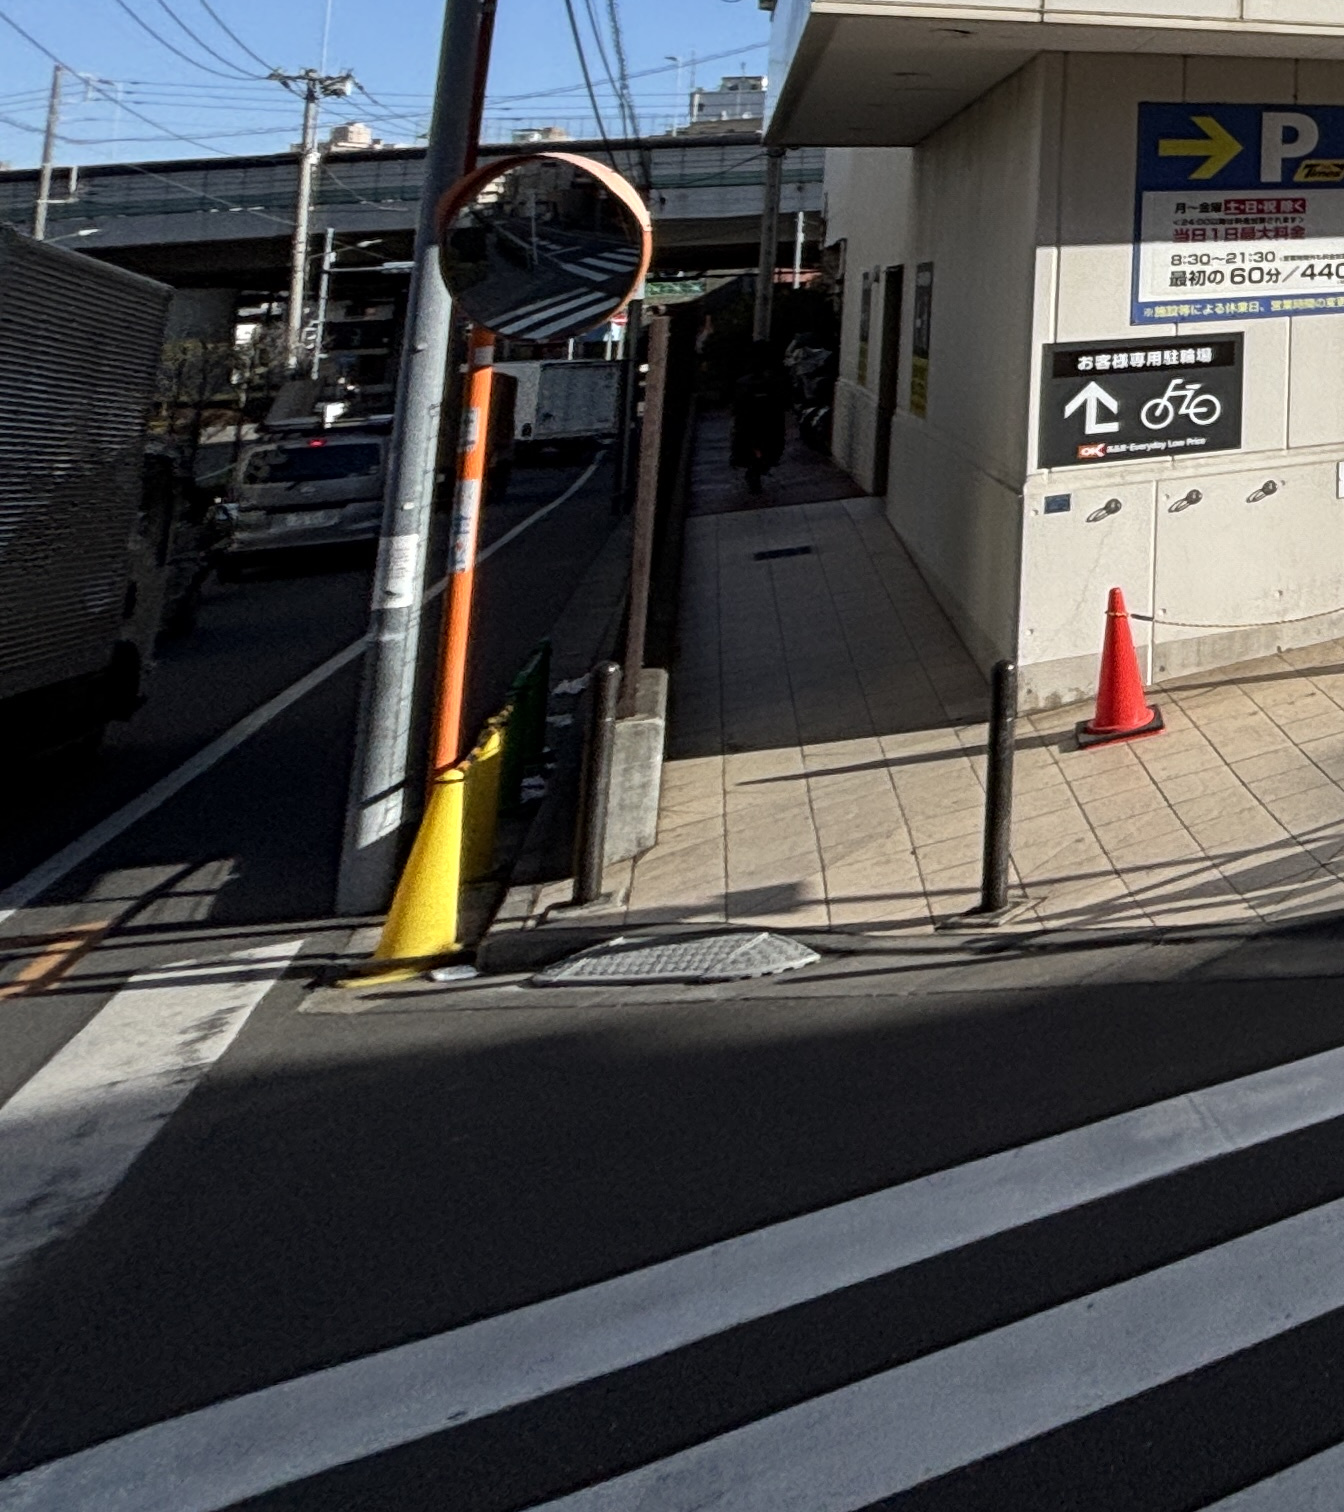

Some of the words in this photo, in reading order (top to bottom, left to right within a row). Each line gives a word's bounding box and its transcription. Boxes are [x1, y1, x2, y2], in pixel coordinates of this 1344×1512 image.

[1260, 112, 1319, 182] P
[1303, 164, 1343, 178] Times
[1172, 226, 1306, 243] 当日1日最大料金
[1077, 347, 1213, 371] お客様専用駐輪場
[1080, 443, 1106, 457] OK
